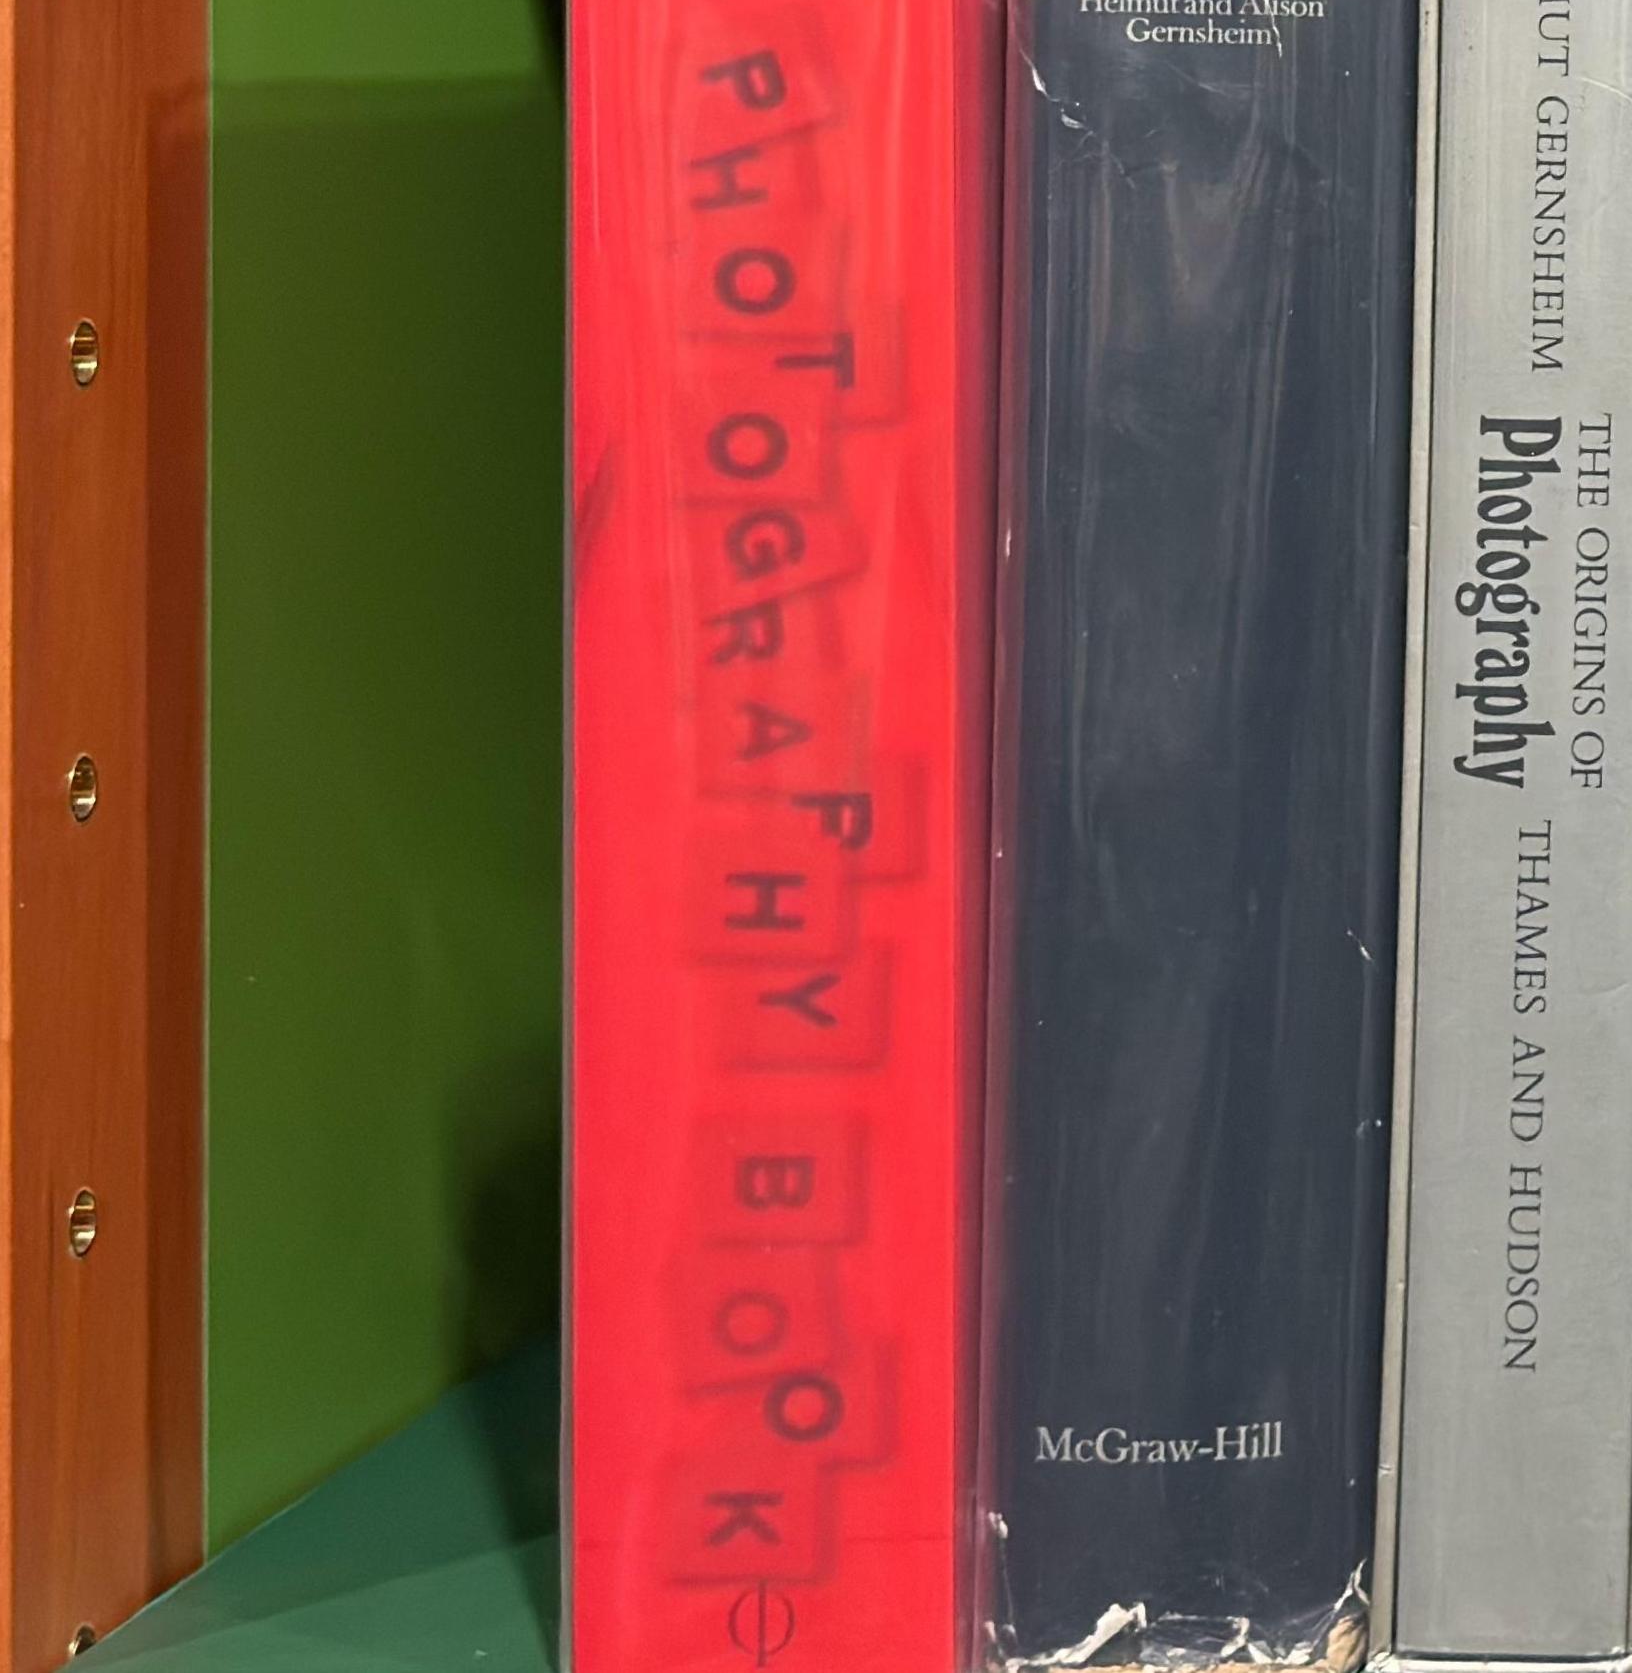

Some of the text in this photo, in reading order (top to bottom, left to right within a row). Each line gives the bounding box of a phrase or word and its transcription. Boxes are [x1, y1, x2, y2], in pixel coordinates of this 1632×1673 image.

[1126, 17, 1273, 46] Gernsheim
[1531, 95, 1570, 373] GERNSHEIM
[689, 47, 874, 1030] PHOTOGRAPHY
[1453, 413, 1563, 790] Photography
[702, 1154, 845, 1548] BOOK
[1036, 1420, 1284, 1465] McGraw-Hill
